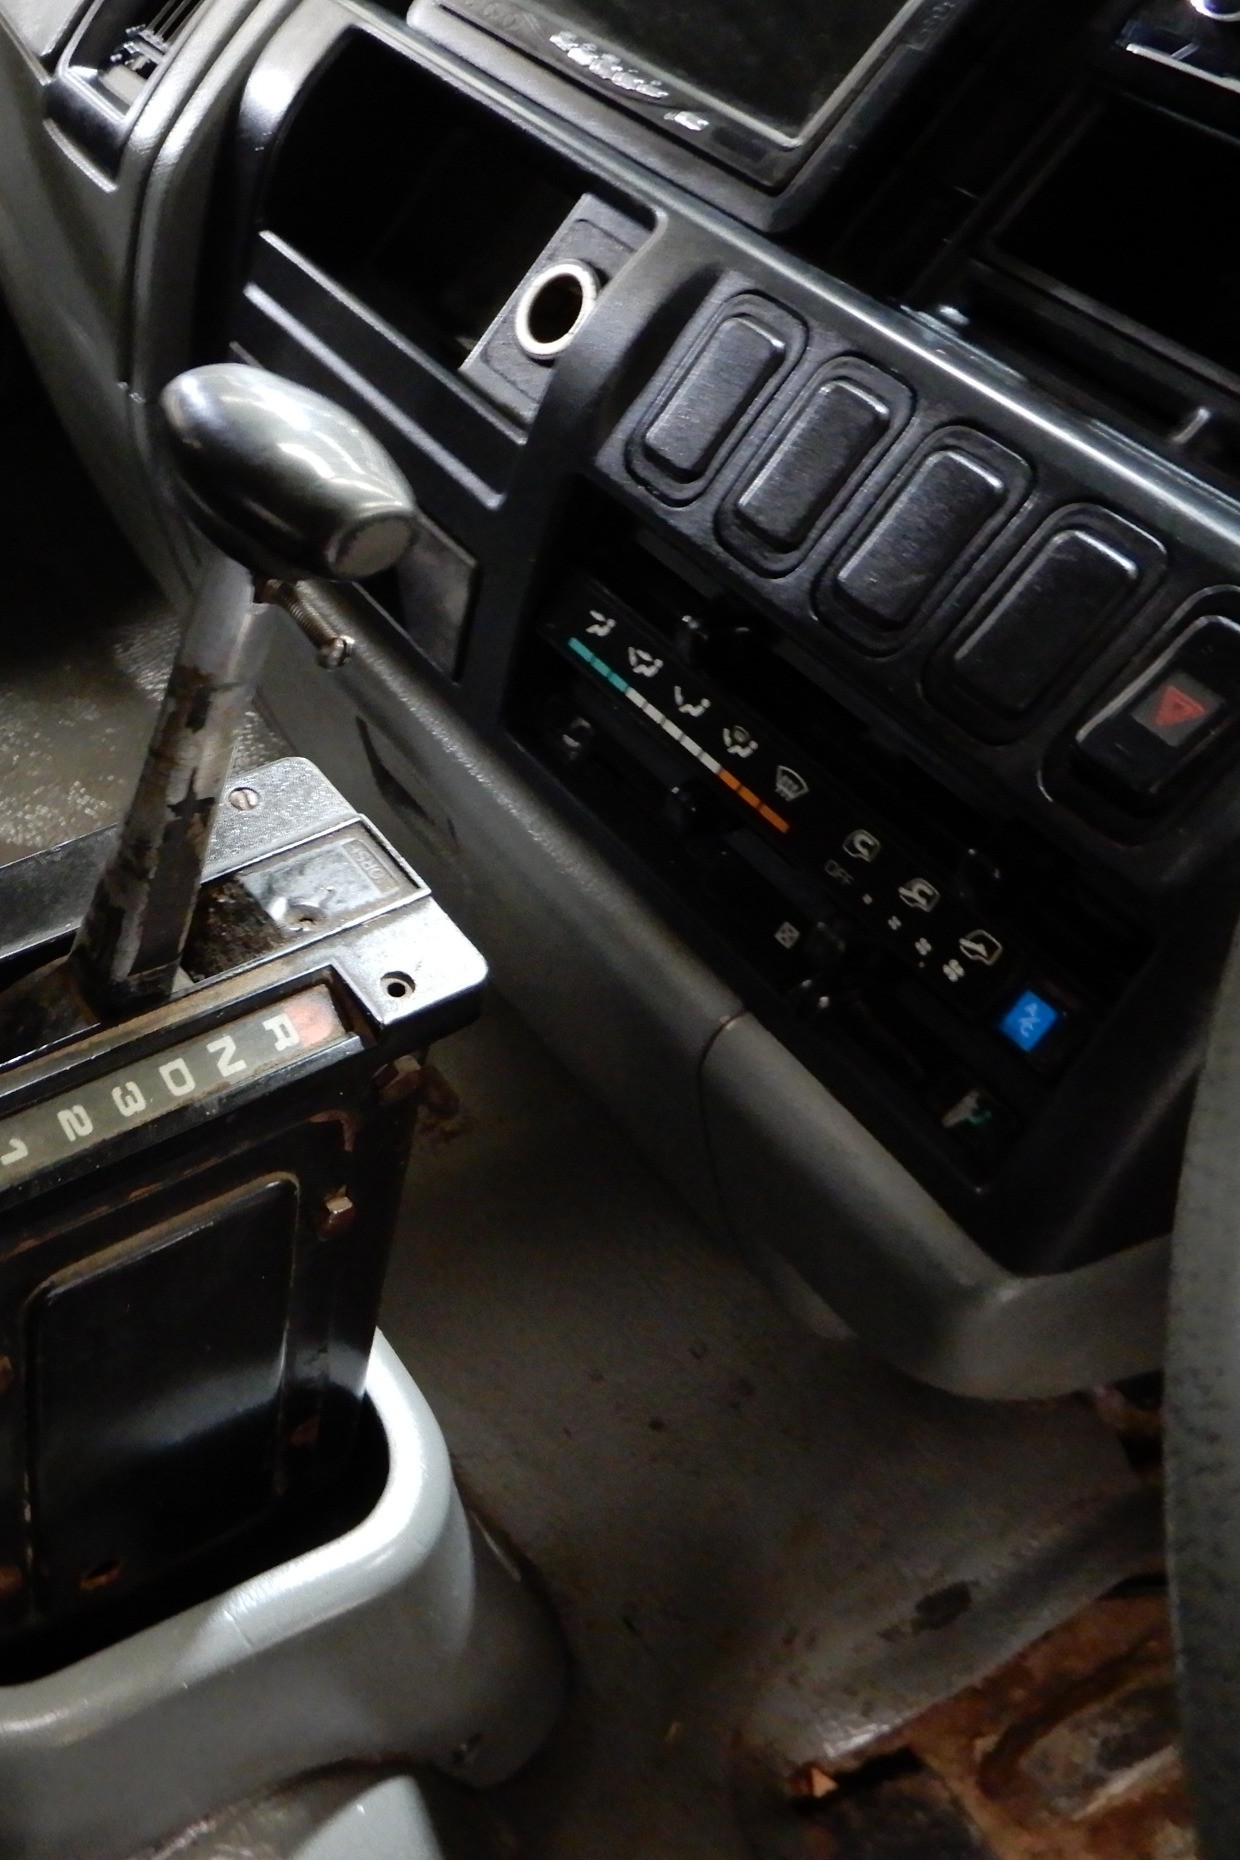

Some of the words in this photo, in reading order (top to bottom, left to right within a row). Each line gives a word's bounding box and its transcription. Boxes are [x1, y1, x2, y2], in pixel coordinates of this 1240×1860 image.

[824, 859, 854, 885] OFF
[262, 1013, 301, 1052] R
[206, 1035, 248, 1078] N
[160, 1057, 196, 1096] D
[111, 1081, 147, 1118] 3
[57, 1104, 94, 1142] 2
